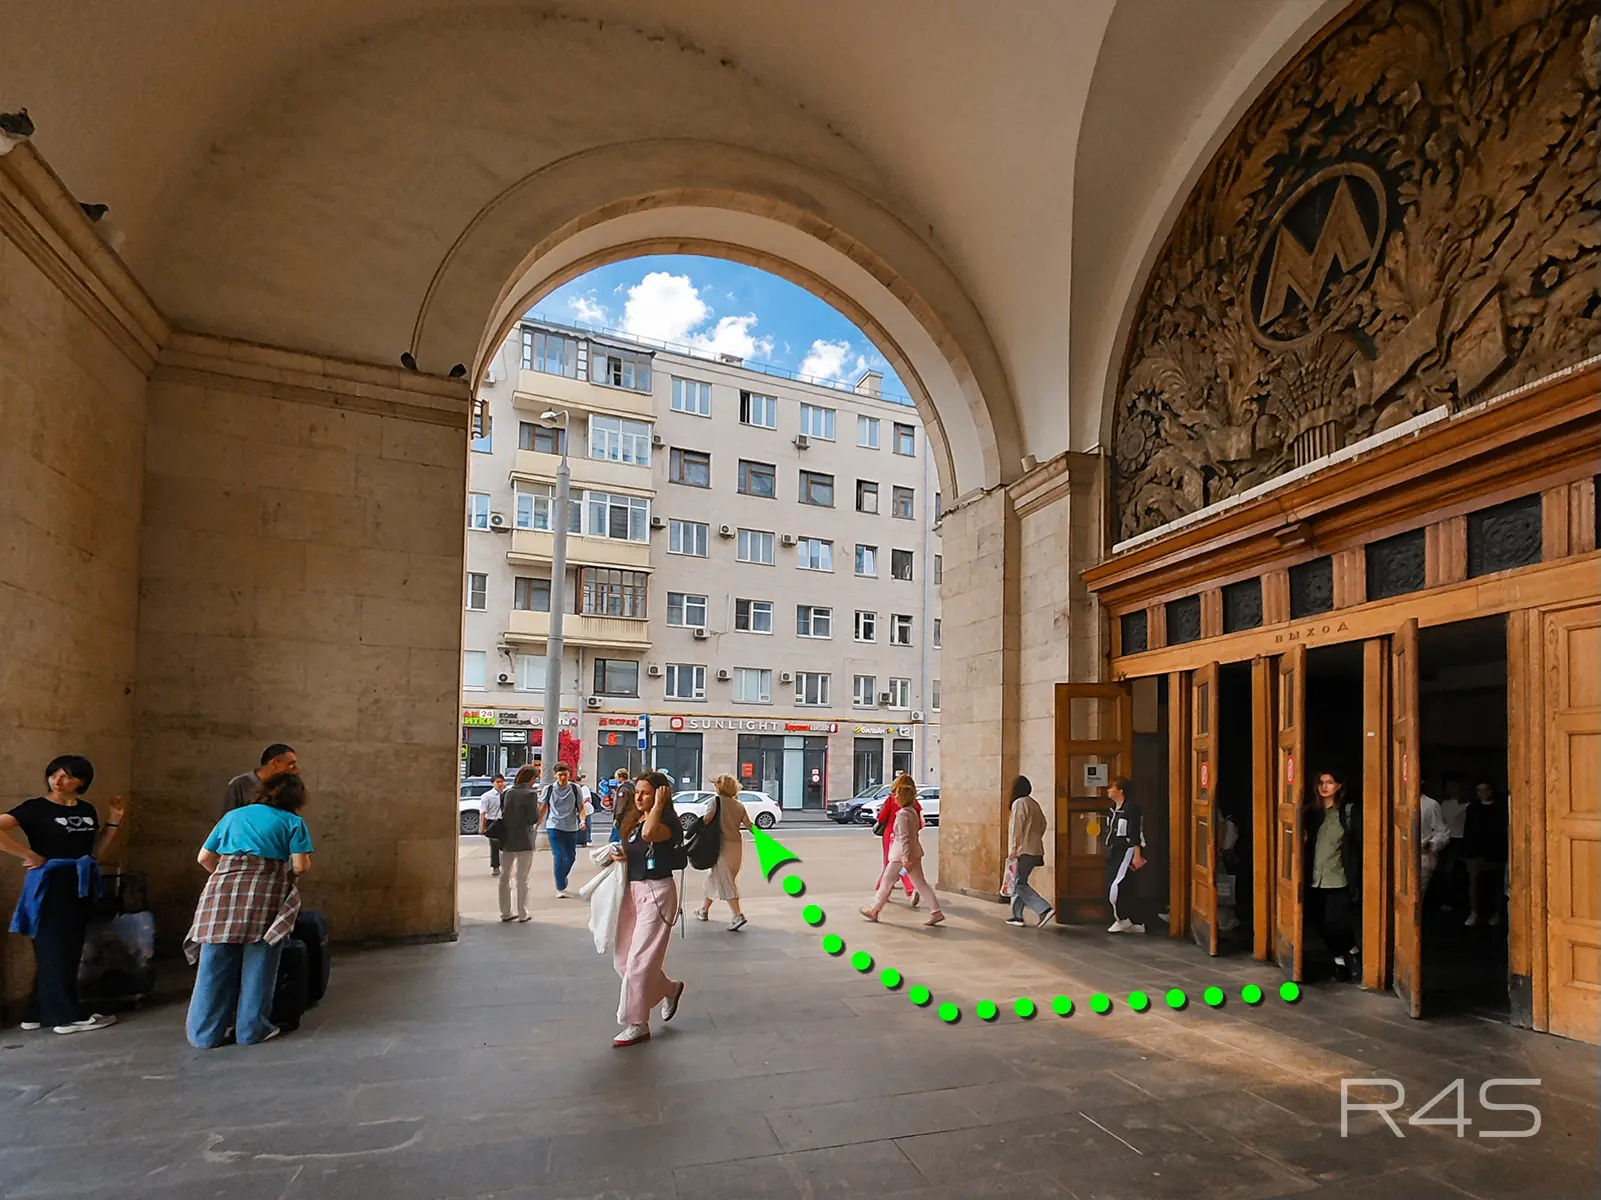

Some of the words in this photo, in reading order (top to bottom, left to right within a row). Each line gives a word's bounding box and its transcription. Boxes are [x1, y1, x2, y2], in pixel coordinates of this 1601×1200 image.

[1275, 620, 1349, 644] ВЫХОД
[481, 710, 493, 718] 24
[690, 719, 779, 731] SUNLIGHT
